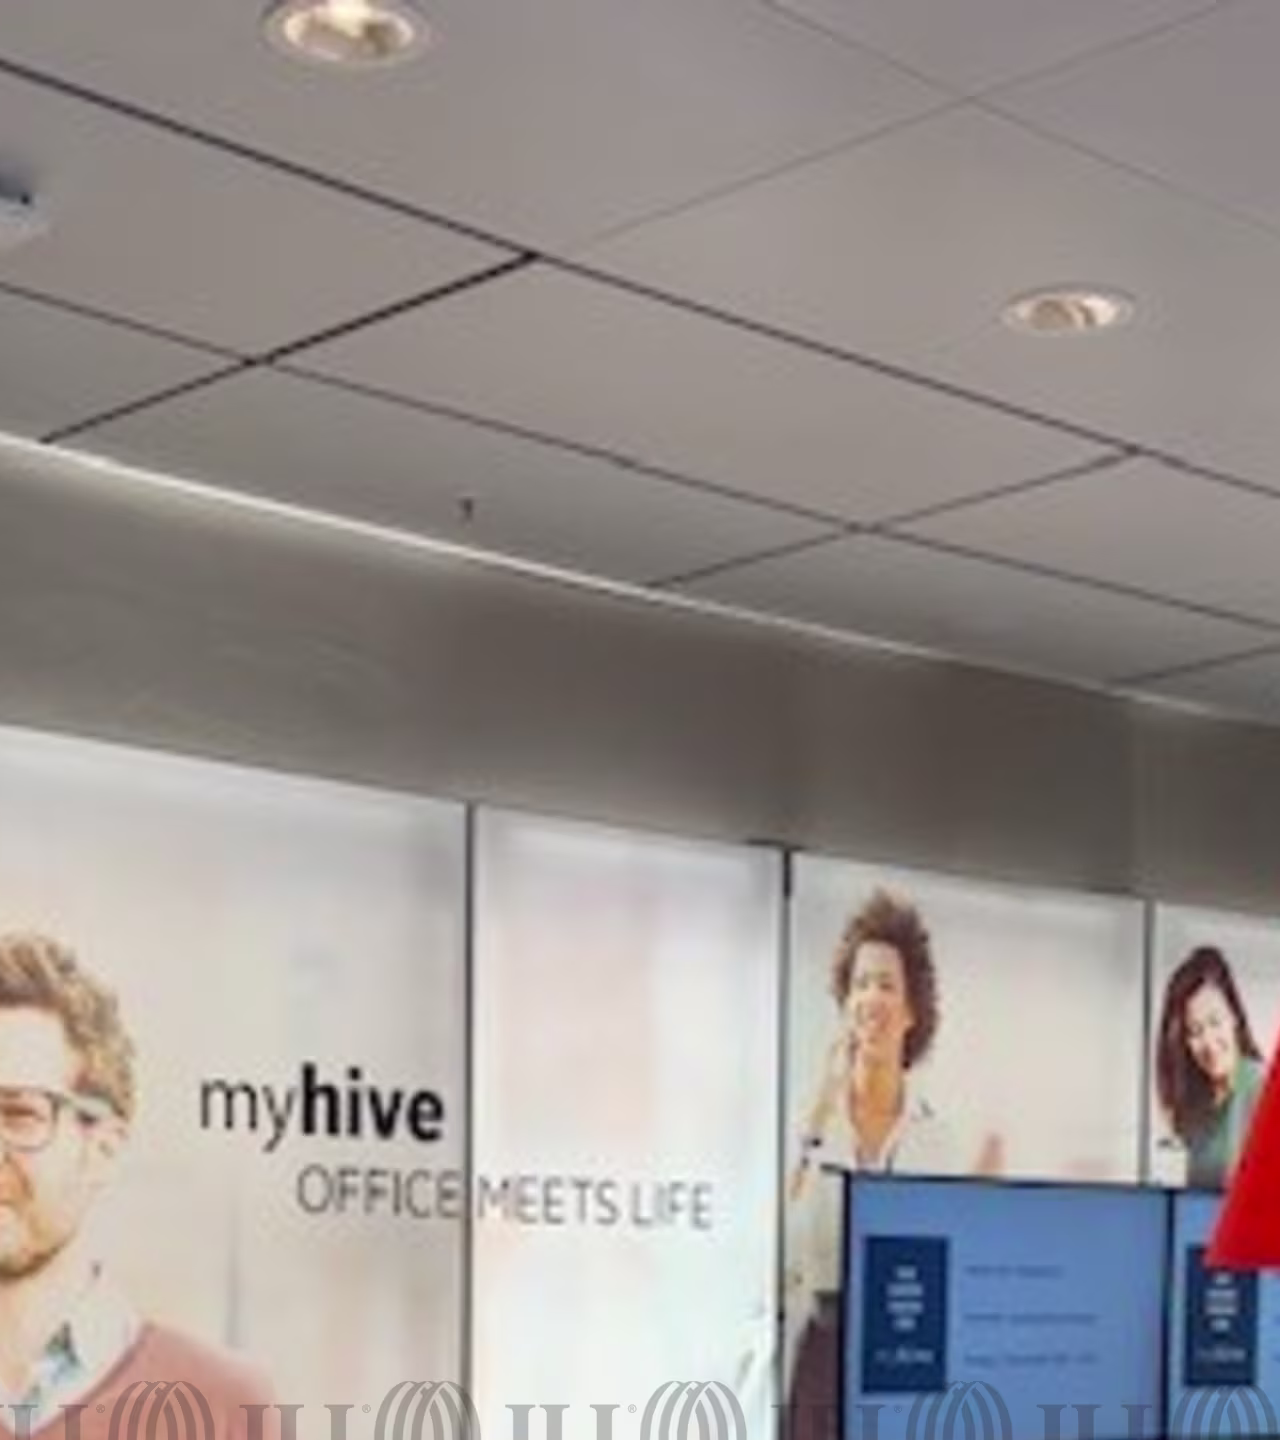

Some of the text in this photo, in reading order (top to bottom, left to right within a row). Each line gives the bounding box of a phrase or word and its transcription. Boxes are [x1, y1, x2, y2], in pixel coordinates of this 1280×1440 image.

[199, 1062, 445, 1152] myhive
[295, 1164, 714, 1230] OFFICE MEETS LIFE
